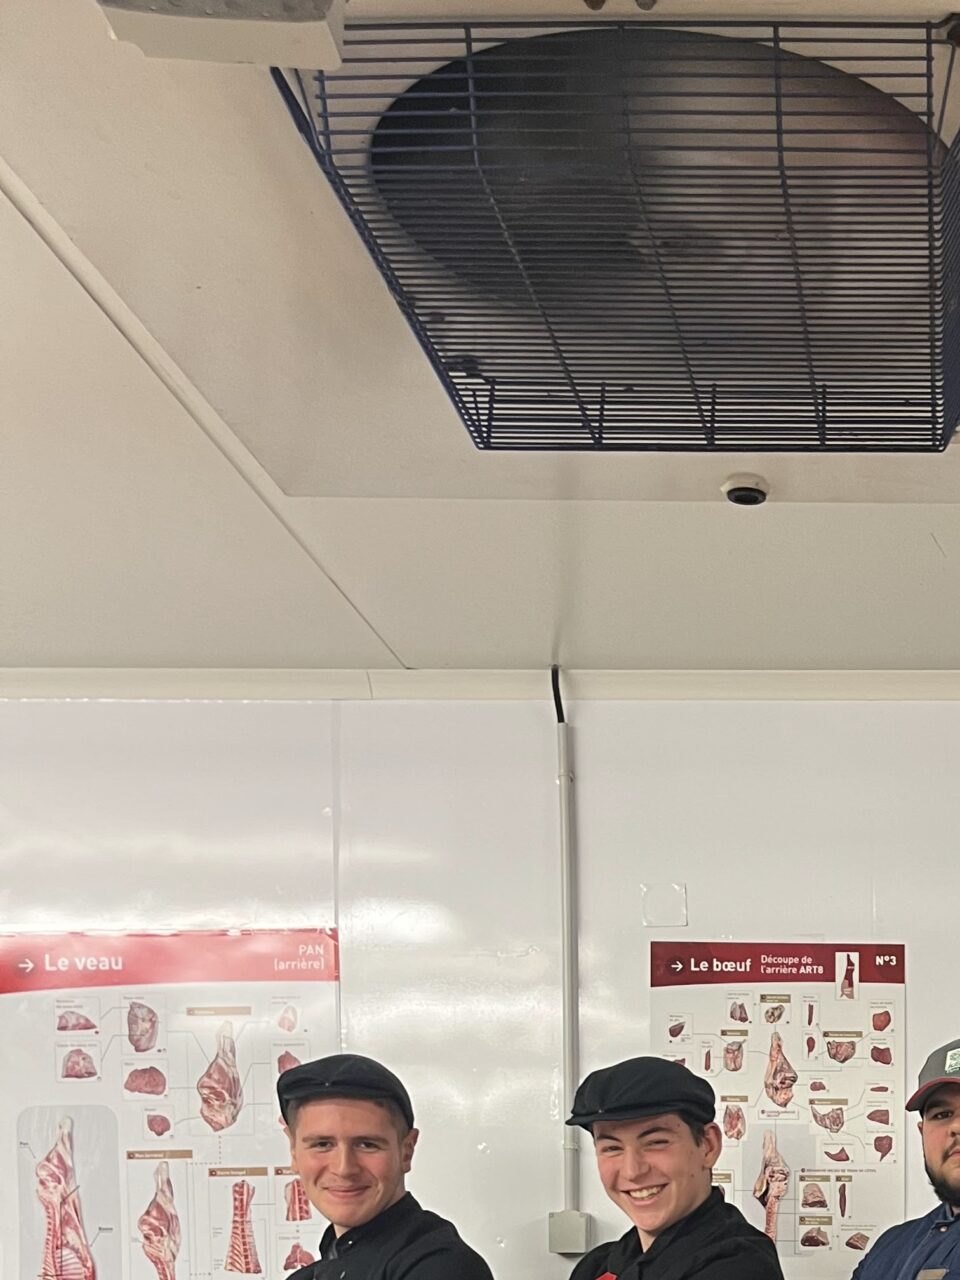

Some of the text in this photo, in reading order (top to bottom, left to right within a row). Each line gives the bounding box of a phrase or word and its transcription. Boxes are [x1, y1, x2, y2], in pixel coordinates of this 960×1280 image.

[299, 944, 325, 956] PAN
[44, 953, 123, 972] Le veau
[274, 957, 325, 970] (arrière)
[690, 958, 752, 972] Le bœuf
[761, 955, 812, 966] Découpe de
[875, 955, 897, 966] N°3
[760, 964, 824, 974] l'arrière ART8
